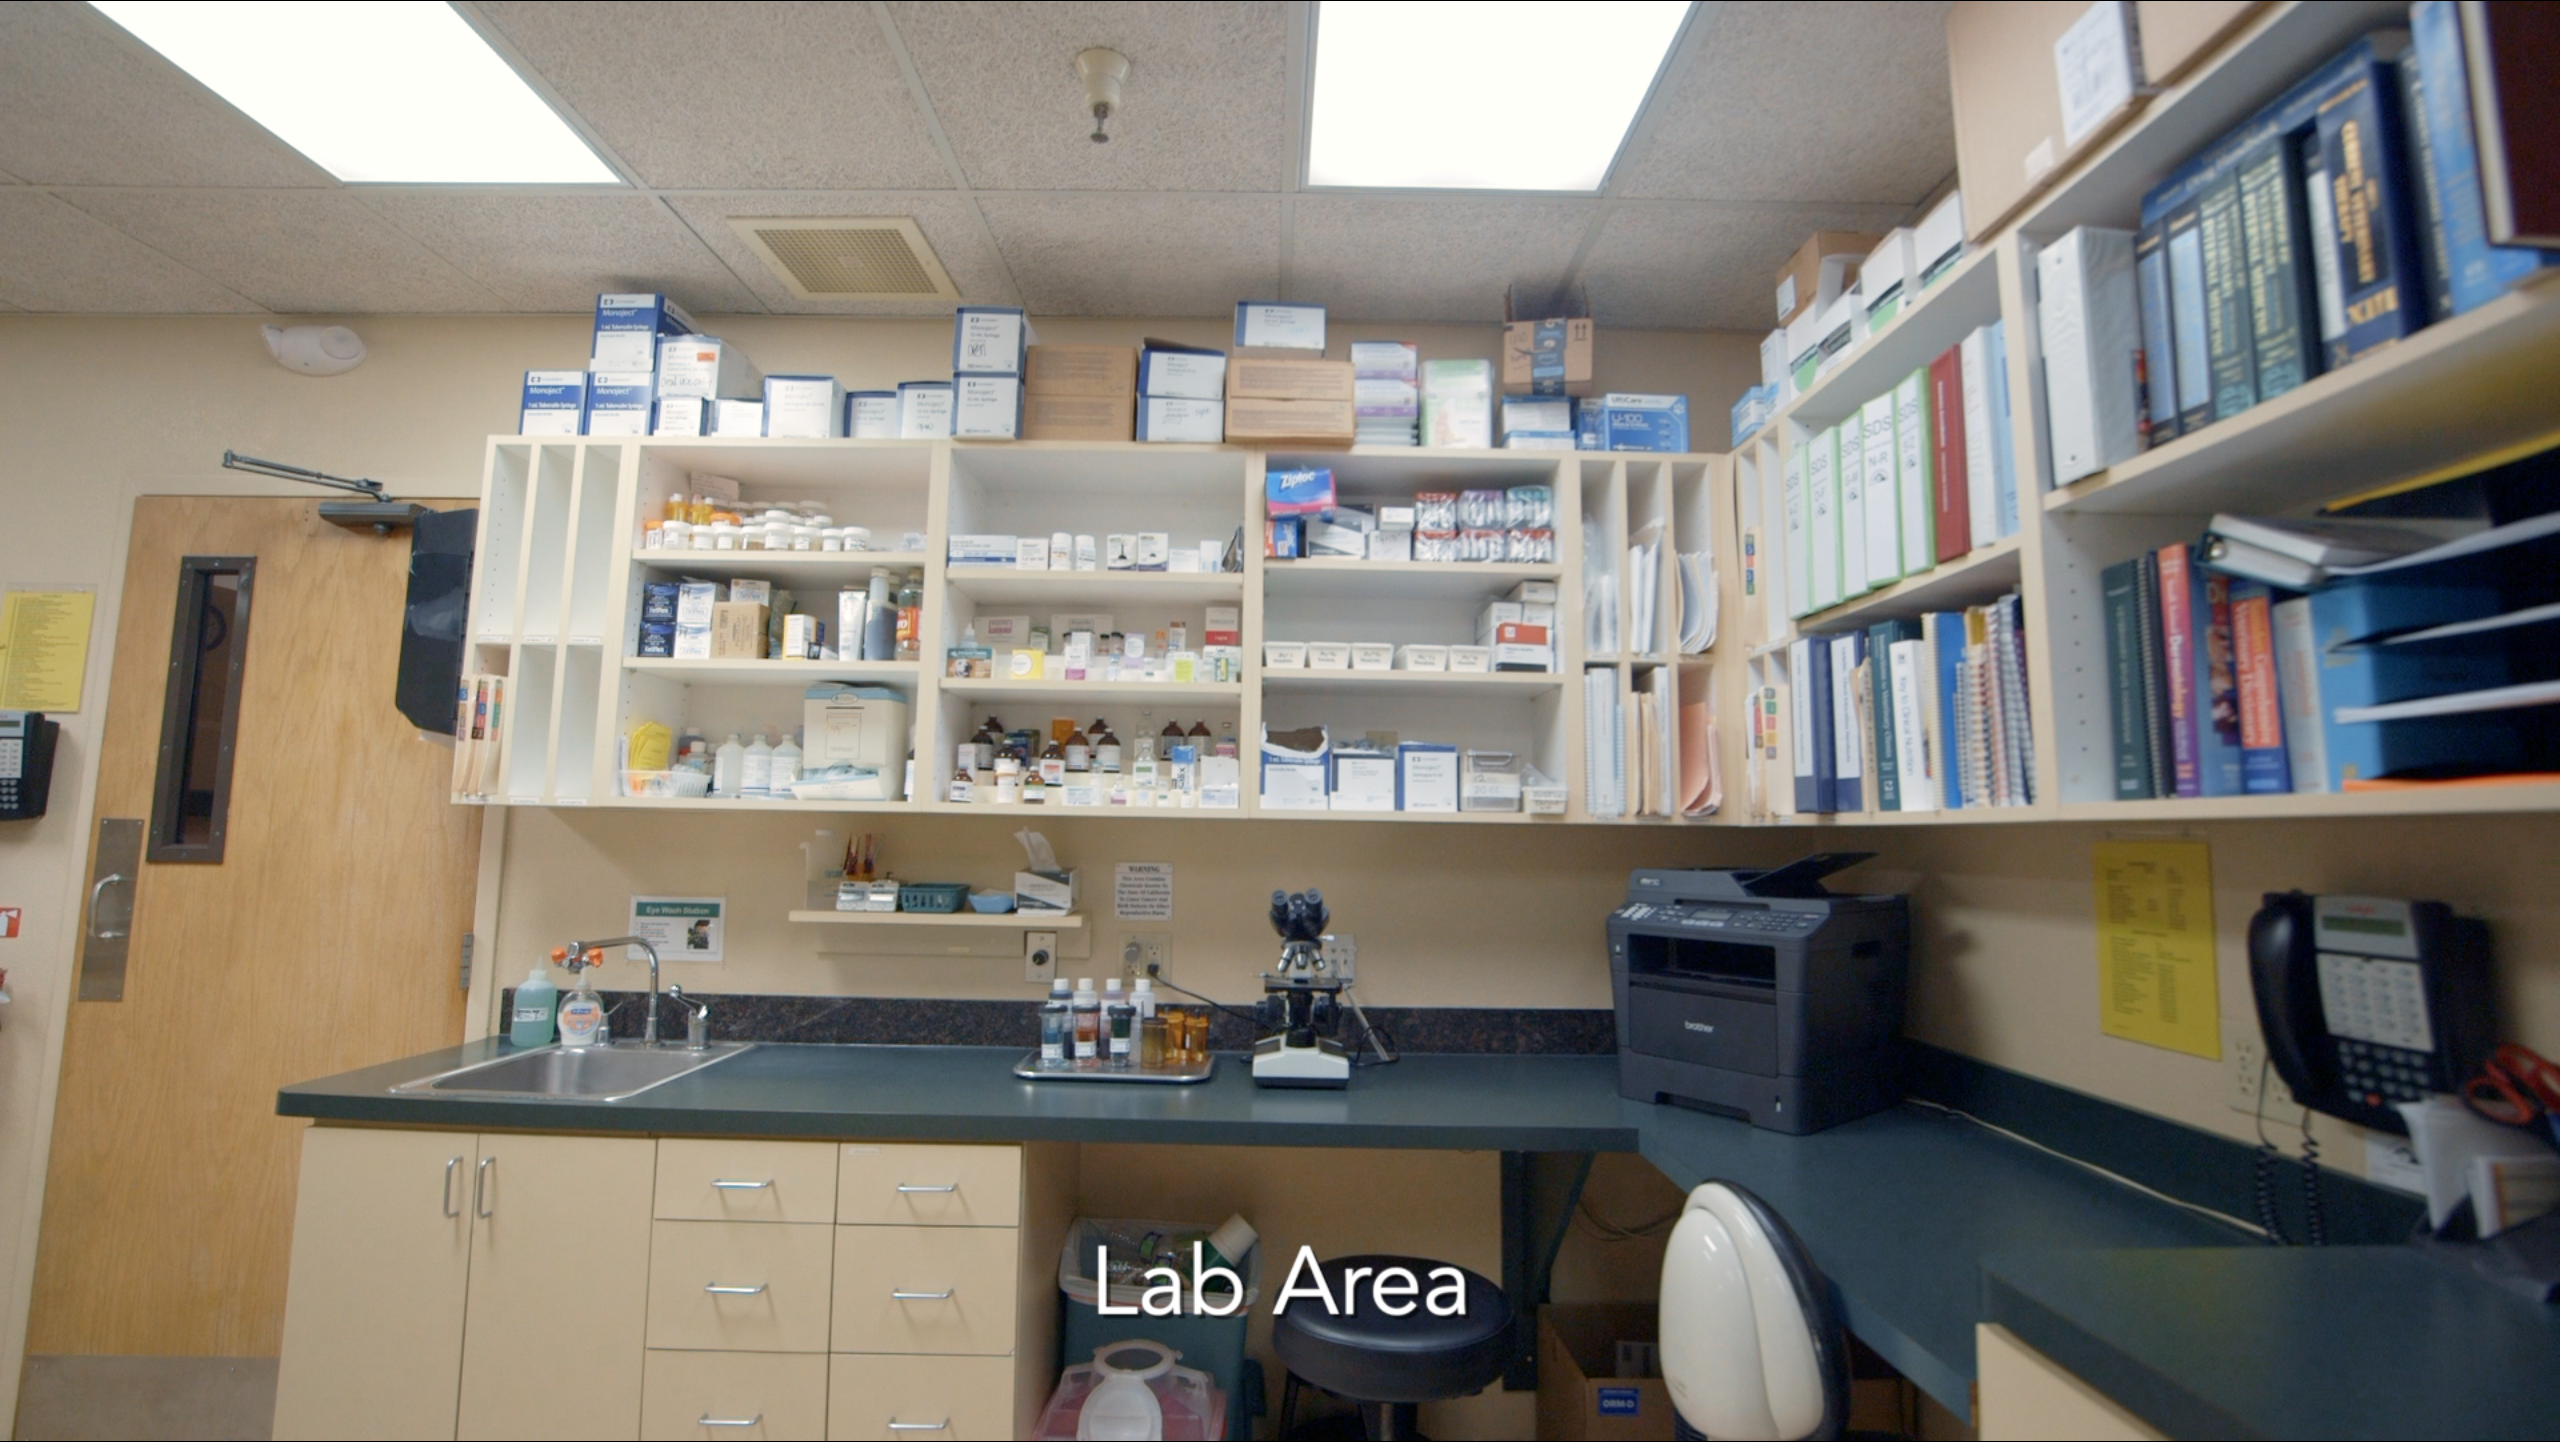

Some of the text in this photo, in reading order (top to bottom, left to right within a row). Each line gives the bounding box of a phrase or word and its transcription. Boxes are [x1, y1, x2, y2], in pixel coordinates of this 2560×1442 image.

[602, 309, 637, 317] Monoject
[529, 387, 565, 396] Monoject
[596, 387, 632, 396] Monoject
[1611, 413, 1643, 423] U-100
[1898, 398, 1917, 423] SDS
[1863, 415, 1892, 439] SDS
[1842, 436, 1860, 459] SDS
[1811, 454, 1828, 475] SDS
[1868, 452, 1888, 468] N-R
[1279, 471, 1316, 490] Ziploc
[1786, 472, 1799, 492] SDS
[2168, 634, 2188, 719] Dermatology
[2234, 602, 2258, 744] Veterinary Dictionary
[1898, 677, 1909, 693] Key
[2249, 654, 2273, 744] Comprehensive
[1880, 690, 1890, 729] Veterinary
[1902, 707, 1912, 734] Clinical
[1884, 731, 1892, 758] Clients
[1904, 737, 1916, 776] Nutrition
[1474, 786, 1486, 794] 20
[646, 906, 660, 915] Eye
[661, 906, 682, 914] Wash
[1684, 1020, 1714, 1034] brother
[1602, 1399, 1634, 1409] ORM-D
